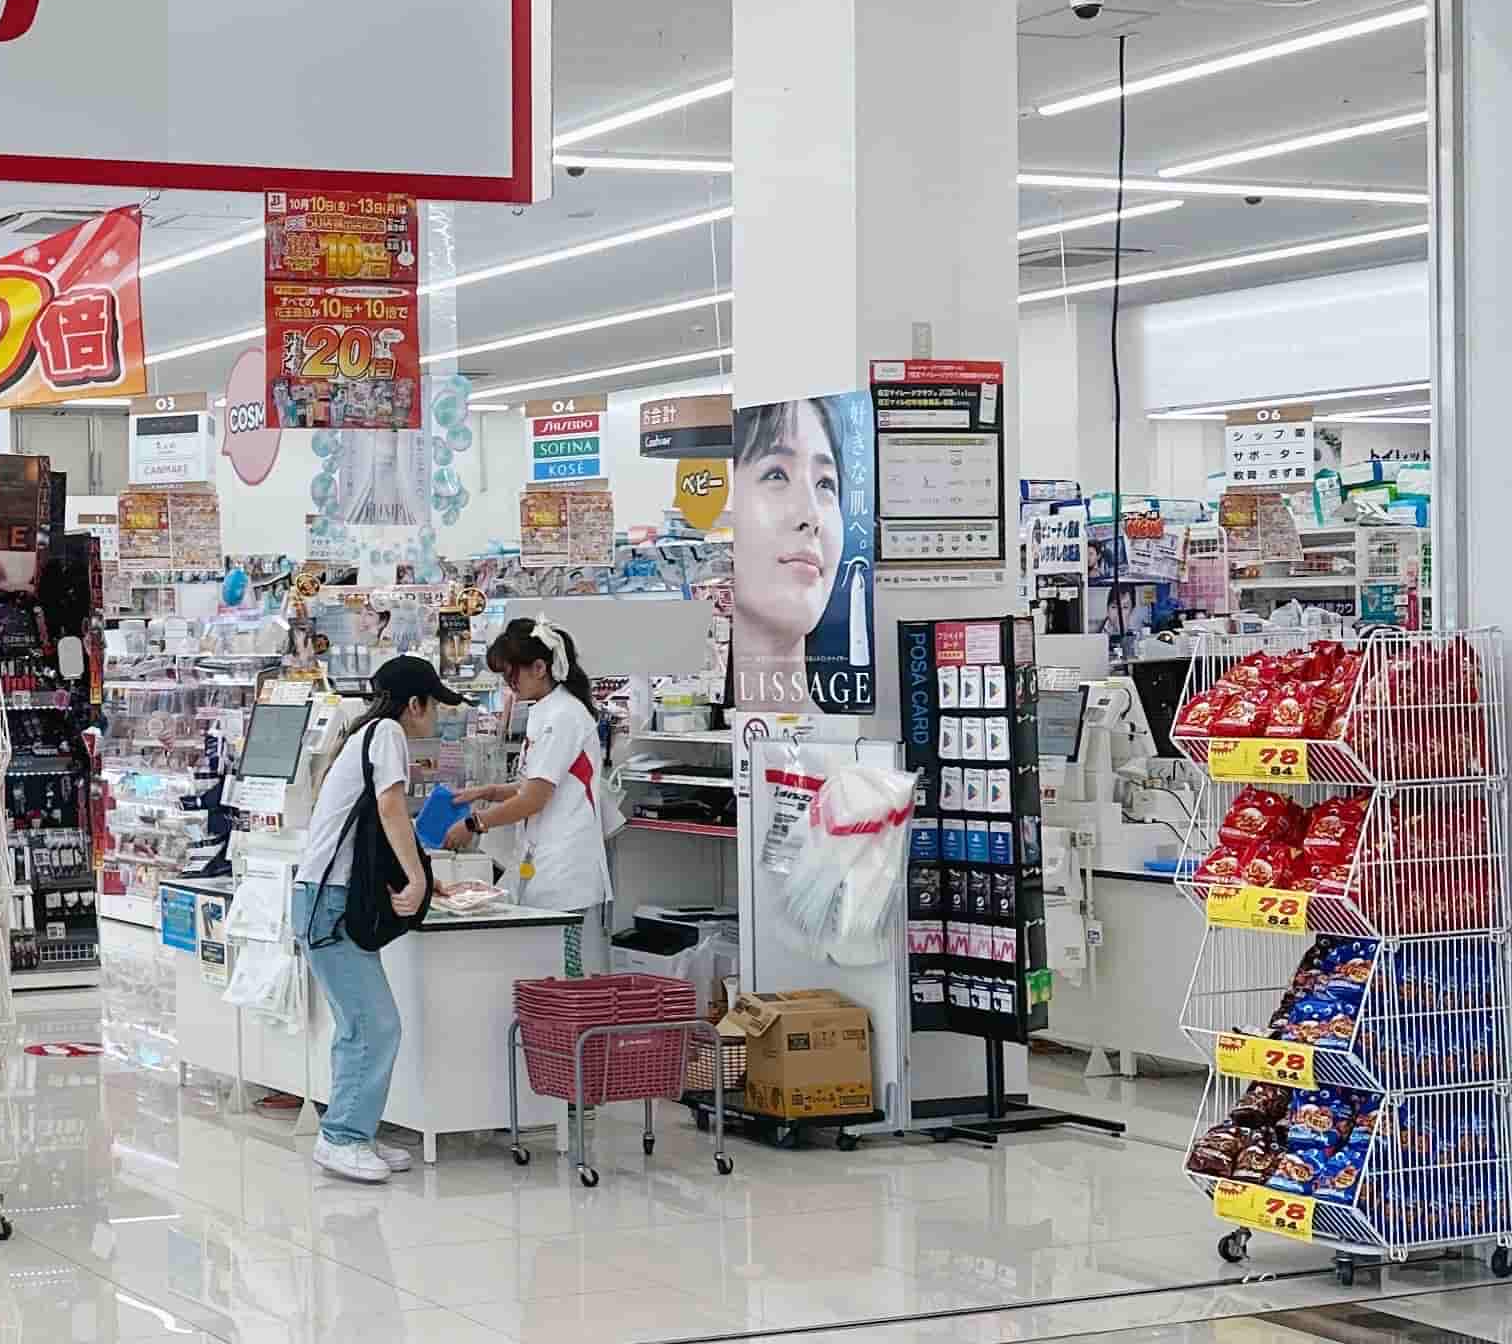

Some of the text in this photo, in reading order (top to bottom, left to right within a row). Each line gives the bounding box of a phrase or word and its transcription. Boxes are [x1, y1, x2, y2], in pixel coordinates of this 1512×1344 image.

[155, 398, 176, 411] 03
[551, 399, 576, 413] 04
[1256, 409, 1282, 421] 06
[541, 419, 593, 433] SHISEIDO
[540, 440, 593, 456] SOFINA
[1234, 448, 1305, 462] サポーター
[680, 471, 724, 496] ベビー
[739, 670, 872, 705] LISSAGE
[910, 632, 929, 745] POSA CARD
[1259, 748, 1300, 765] 78
[1270, 766, 1292, 775] 84
[1266, 1050, 1305, 1070] 78
